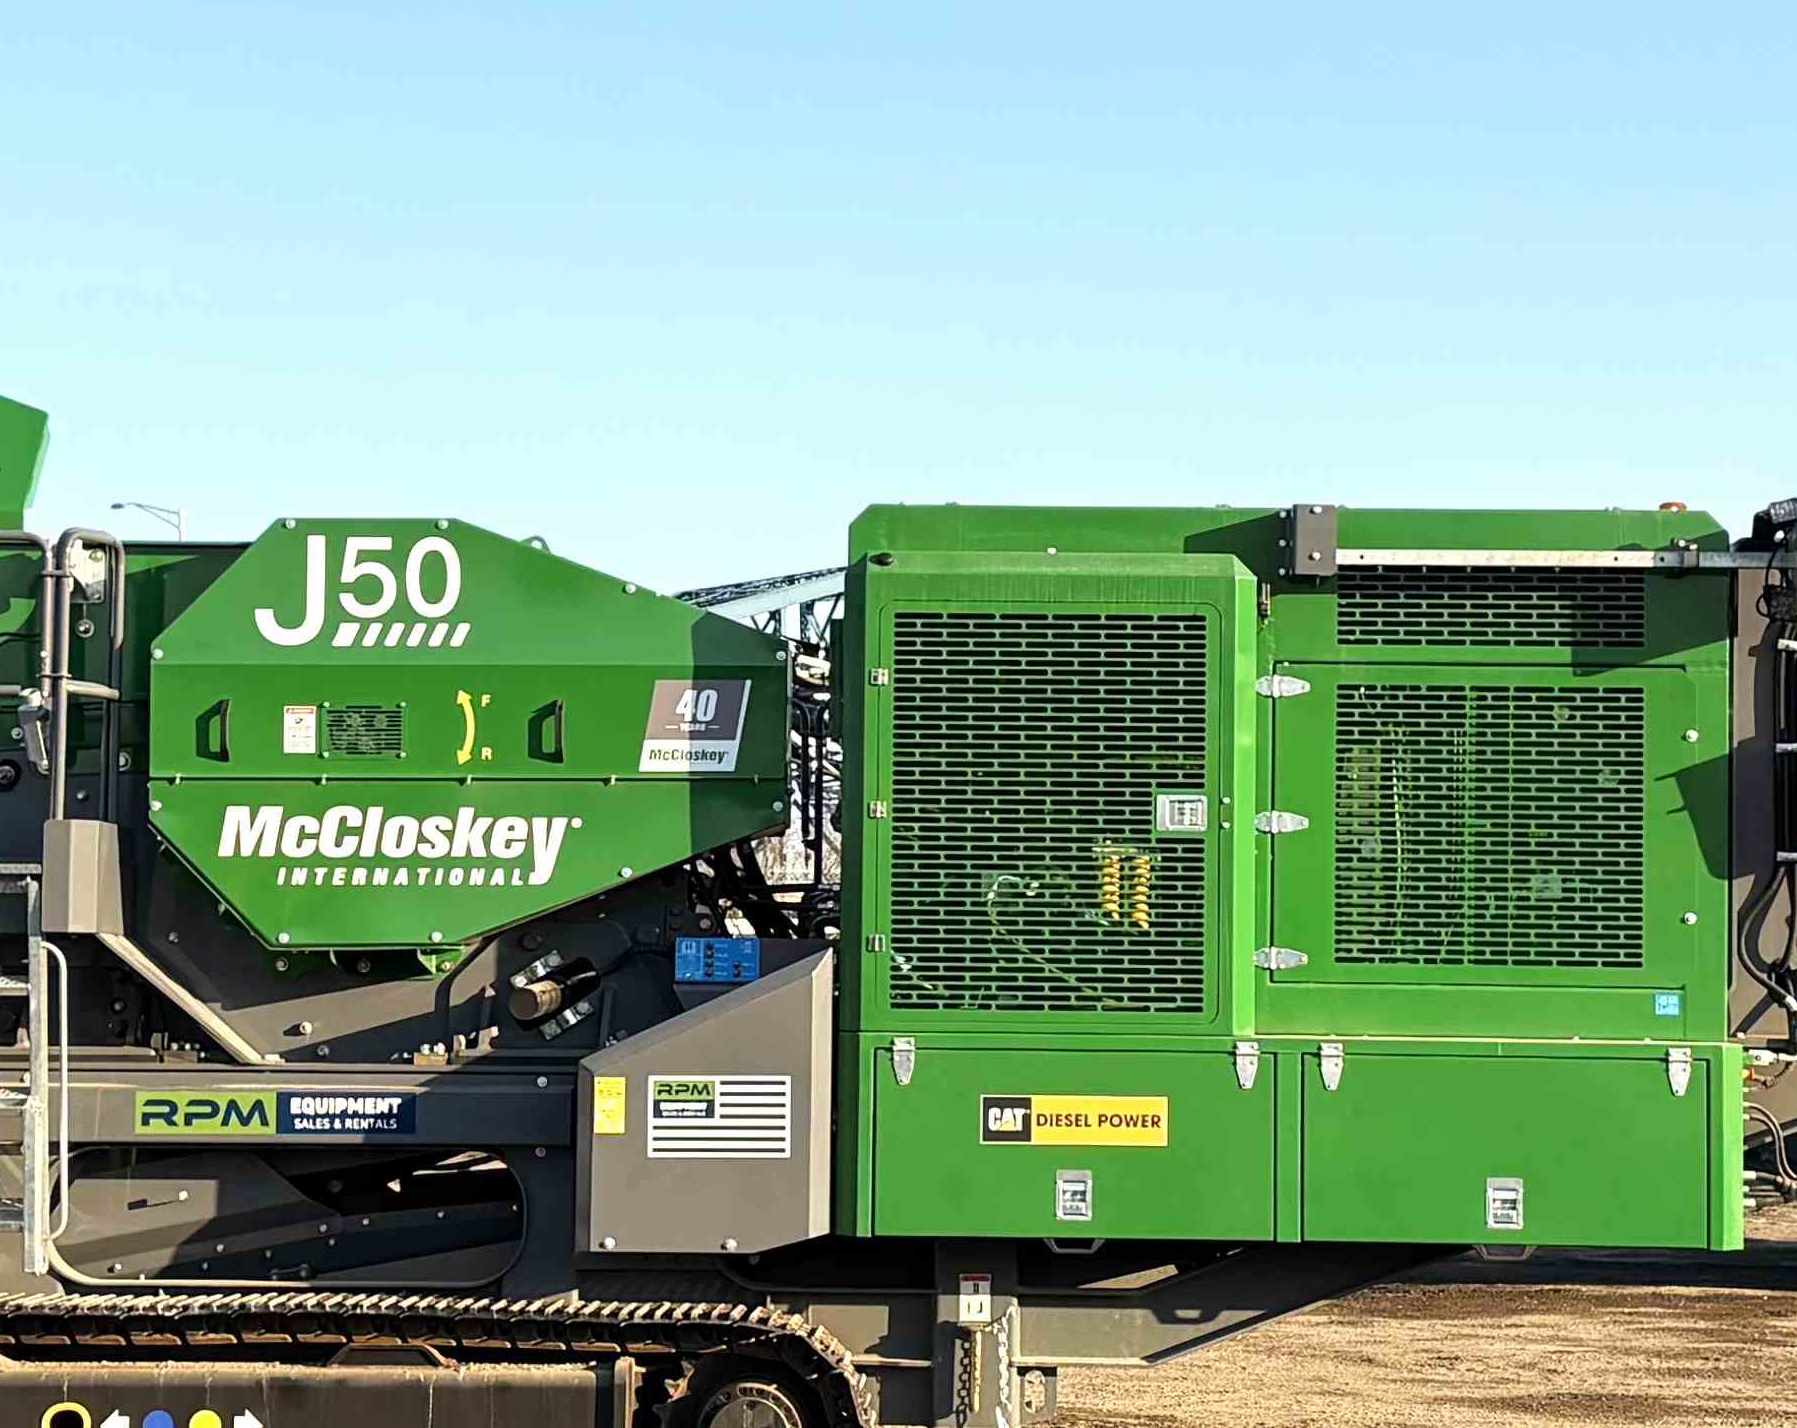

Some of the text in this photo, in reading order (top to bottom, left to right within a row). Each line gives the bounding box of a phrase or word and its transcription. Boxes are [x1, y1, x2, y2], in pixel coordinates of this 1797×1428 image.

[254, 534, 462, 646] J50
[480, 694, 492, 708] F
[675, 688, 718, 722] 40
[480, 747, 493, 761] R
[648, 748, 727, 765] McCloskey
[217, 805, 570, 886] McCloskey
[276, 866, 524, 886] INTERNATIONAL
[656, 1083, 712, 1097] RPM
[140, 1098, 270, 1127] RPM
[289, 1097, 403, 1116] EQUIPMENT
[293, 1117, 398, 1130] SALES & RENTALS
[987, 1107, 1027, 1132] CAT
[1036, 1113, 1162, 1129] DIESEL POWER
